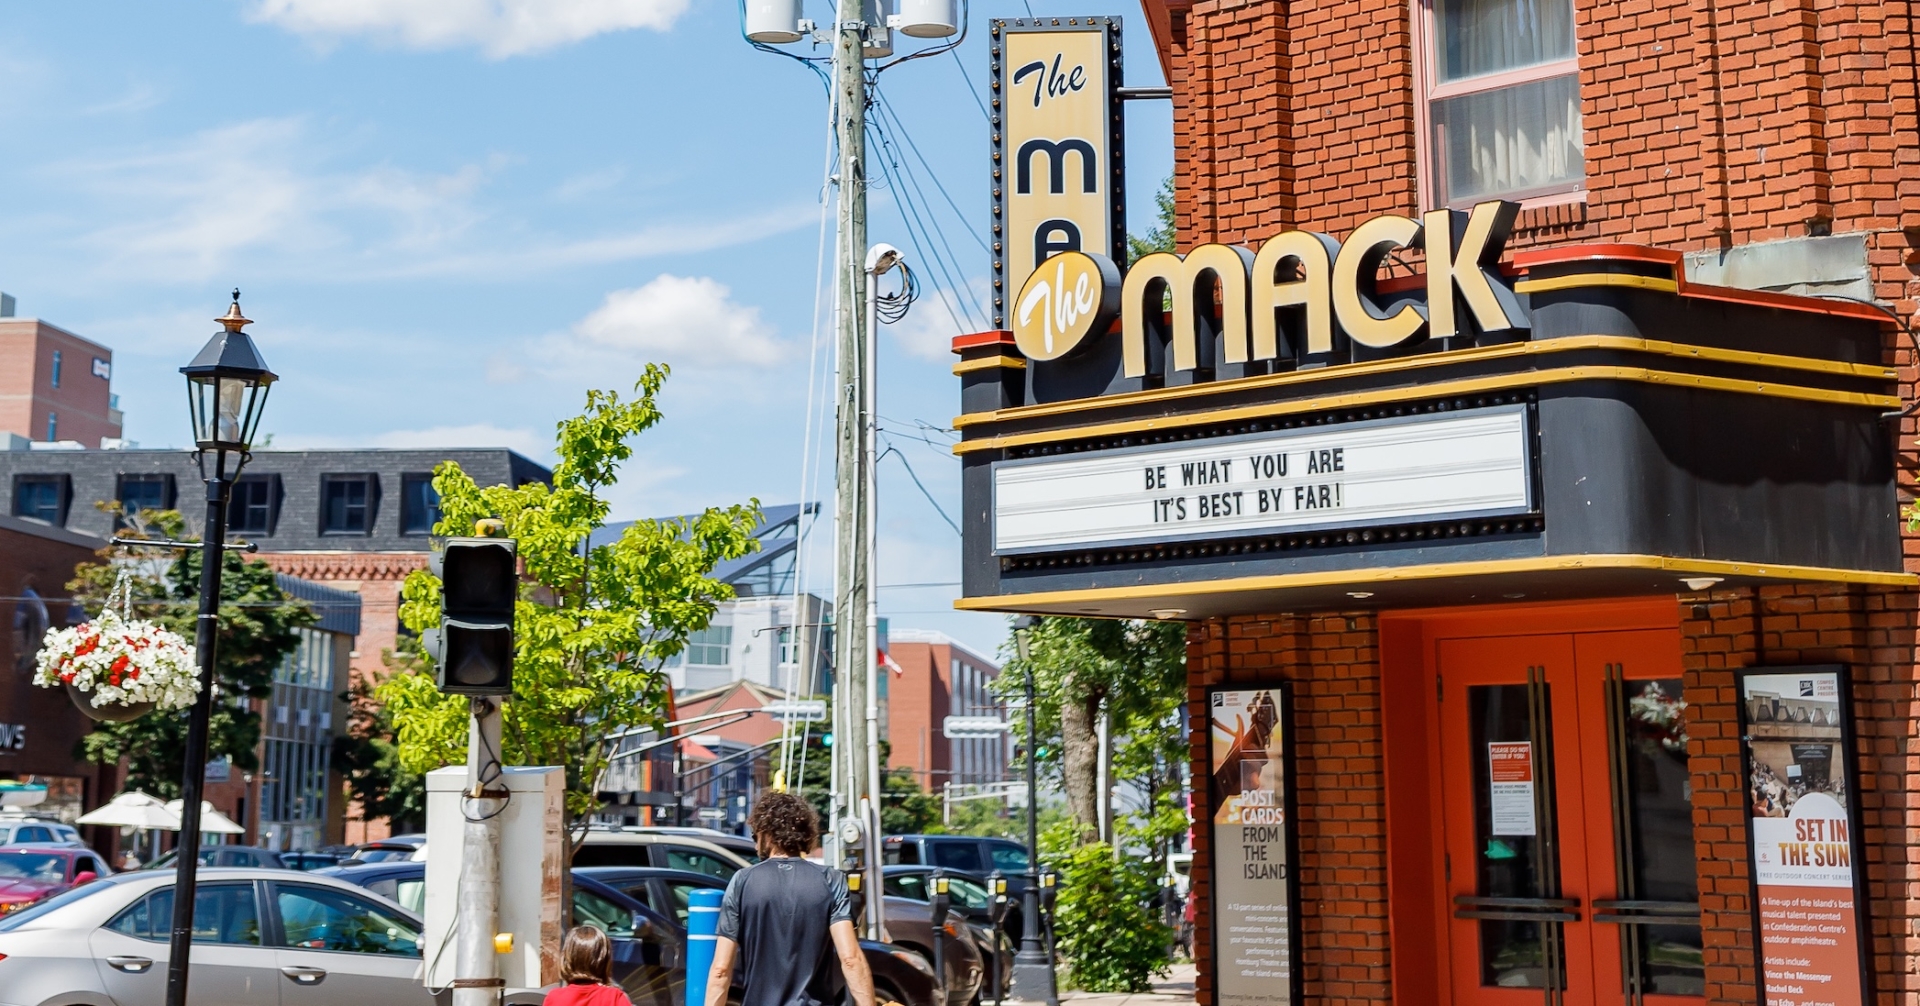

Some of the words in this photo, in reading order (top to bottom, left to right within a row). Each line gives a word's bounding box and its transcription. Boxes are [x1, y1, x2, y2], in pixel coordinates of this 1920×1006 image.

[1013, 53, 1087, 108] The
[1019, 261, 1094, 354] The
[1122, 200, 1518, 378] MACK
[1145, 466, 1166, 490] BE
[1181, 459, 1231, 486] WHAT
[1250, 453, 1288, 480] YOU
[1307, 448, 1344, 475] ARE
[1154, 497, 1187, 523] IT'S
[1199, 491, 1243, 518] BEST
[1258, 488, 1283, 513] BY
[1294, 483, 1341, 510] FAR!
[1241, 790, 1274, 806] POST
[1242, 808, 1283, 824] CARDS
[1243, 827, 1278, 842] FROM
[1795, 819, 1825, 842] SET
[1829, 819, 1848, 842] IN
[1243, 845, 1267, 861] THE
[1778, 843, 1810, 866] THE
[1814, 843, 1850, 867] SUN
[1244, 864, 1286, 879] ISLAND
[1761, 897, 1767, 905] A
[1768, 898, 1790, 908] line-up
[1792, 898, 1799, 906] of
[1800, 898, 1811, 907] the
[1813, 898, 1837, 908] Island's
[1839, 900, 1853, 908] best
[1762, 910, 1785, 919] musical
[1787, 911, 1806, 919] talent
[1807, 912, 1841, 921] presented
[1763, 922, 1769, 930] in
[1770, 922, 1817, 932] Confederation
[1818, 924, 1846, 934] Centre's
[1763, 935, 1790, 943] outdoor
[1791, 937, 1838, 946] amphitheatre.
[1764, 956, 1785, 965] Artists
[1785, 957, 1811, 967] include:
[1765, 970, 1783, 979] Vince
[1784, 971, 1795, 979] the
[1796, 972, 1832, 983] Messenger
[1766, 984, 1787, 993] Rachel
[1788, 985, 1804, 994] Beck
